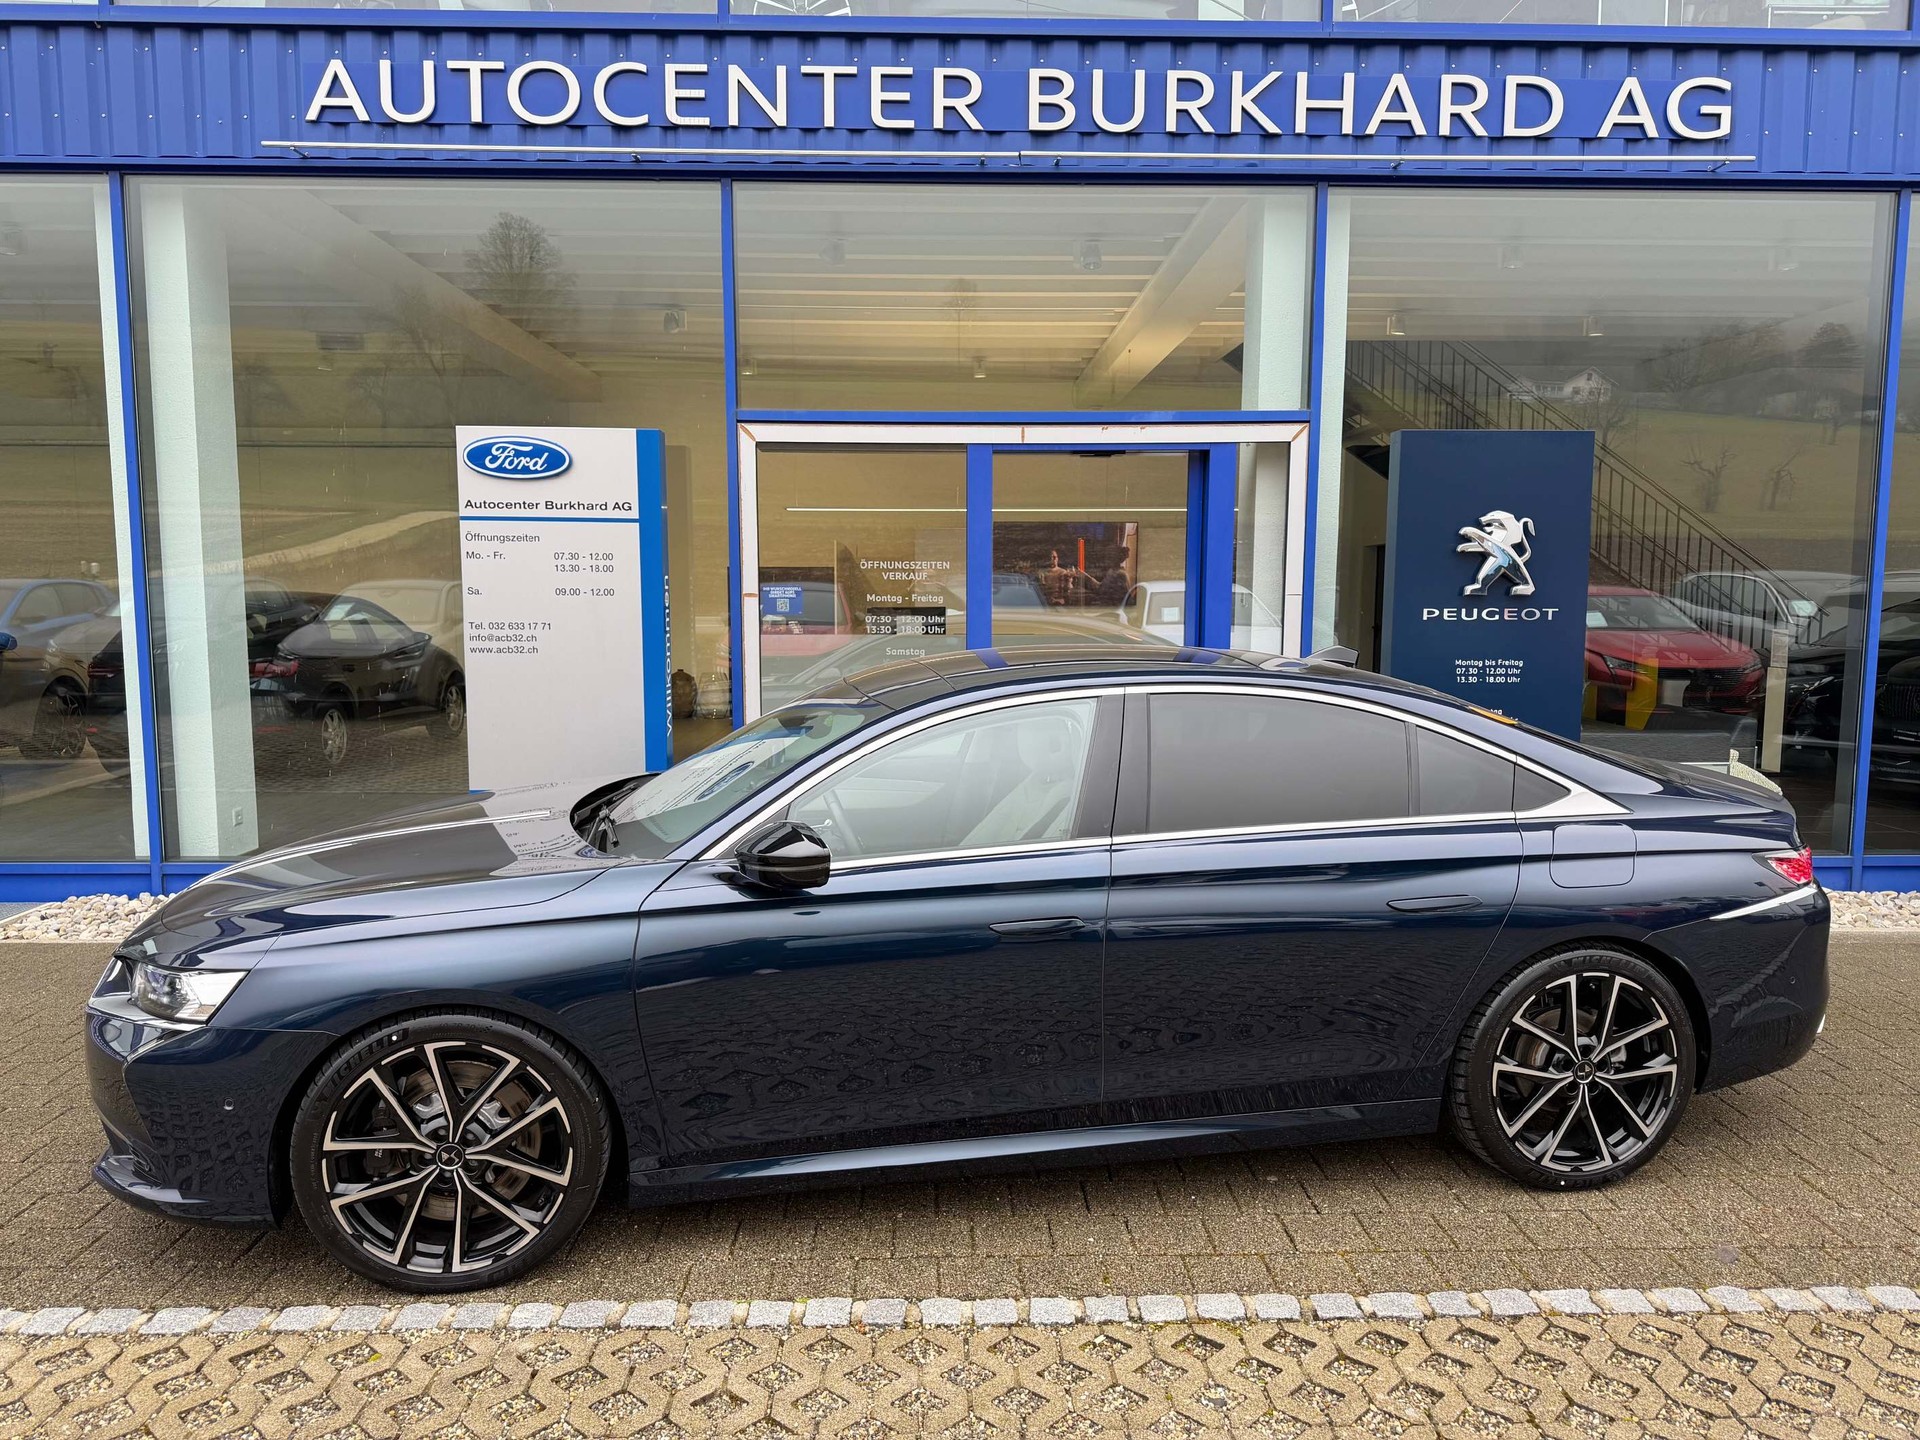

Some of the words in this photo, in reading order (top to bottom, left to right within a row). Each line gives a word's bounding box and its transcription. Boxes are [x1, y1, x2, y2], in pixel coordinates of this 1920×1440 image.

[304, 57, 984, 130] AUTOCENTER
[1028, 67, 1564, 140] BURKHARD
[1597, 76, 1734, 142] AG
[484, 442, 549, 472] Ford
[464, 499, 541, 511] Autocenter
[544, 500, 608, 511] Burkhard
[612, 501, 633, 512] AG
[465, 531, 540, 544] Öffnungszeiten
[466, 551, 484, 560] Mo.
[493, 551, 506, 560] Fr.
[553, 552, 580, 561] 07.30
[589, 552, 614, 561] 12.00
[554, 564, 580, 573] 13.30
[589, 564, 615, 573] 18.00
[860, 558, 950, 570] ÖFFNUNGSZEITEN
[882, 572, 928, 581] VERKAUF
[467, 587, 483, 596] Sa.
[555, 587, 581, 597] 09.00
[590, 588, 615, 597] 12.00
[866, 593, 903, 604] Montag
[911, 593, 944, 604] Freitag
[865, 615, 892, 623] 07:30
[902, 615, 926, 623] 12:00
[928, 615, 945, 623] Uhr
[1422, 607, 1559, 621] PEUGEOT
[468, 621, 486, 631] Tel.
[488, 622, 506, 631] 032
[508, 622, 526, 631] 633
[527, 622, 538, 631] 17
[540, 622, 552, 631] 71
[866, 625, 892, 634] 13:30
[902, 625, 926, 634] 18:00
[927, 625, 945, 634] Uhr
[469, 633, 538, 643] info@acb32.ch
[469, 645, 539, 654] www.acb32.ch
[885, 647, 926, 657] Samstag
[1455, 659, 1483, 667] Montag
[1497, 659, 1524, 667] Freitag
[1456, 667, 1478, 675] 07.30
[1486, 667, 1506, 675] 12.00
[1507, 667, 1521, 675] Uhr
